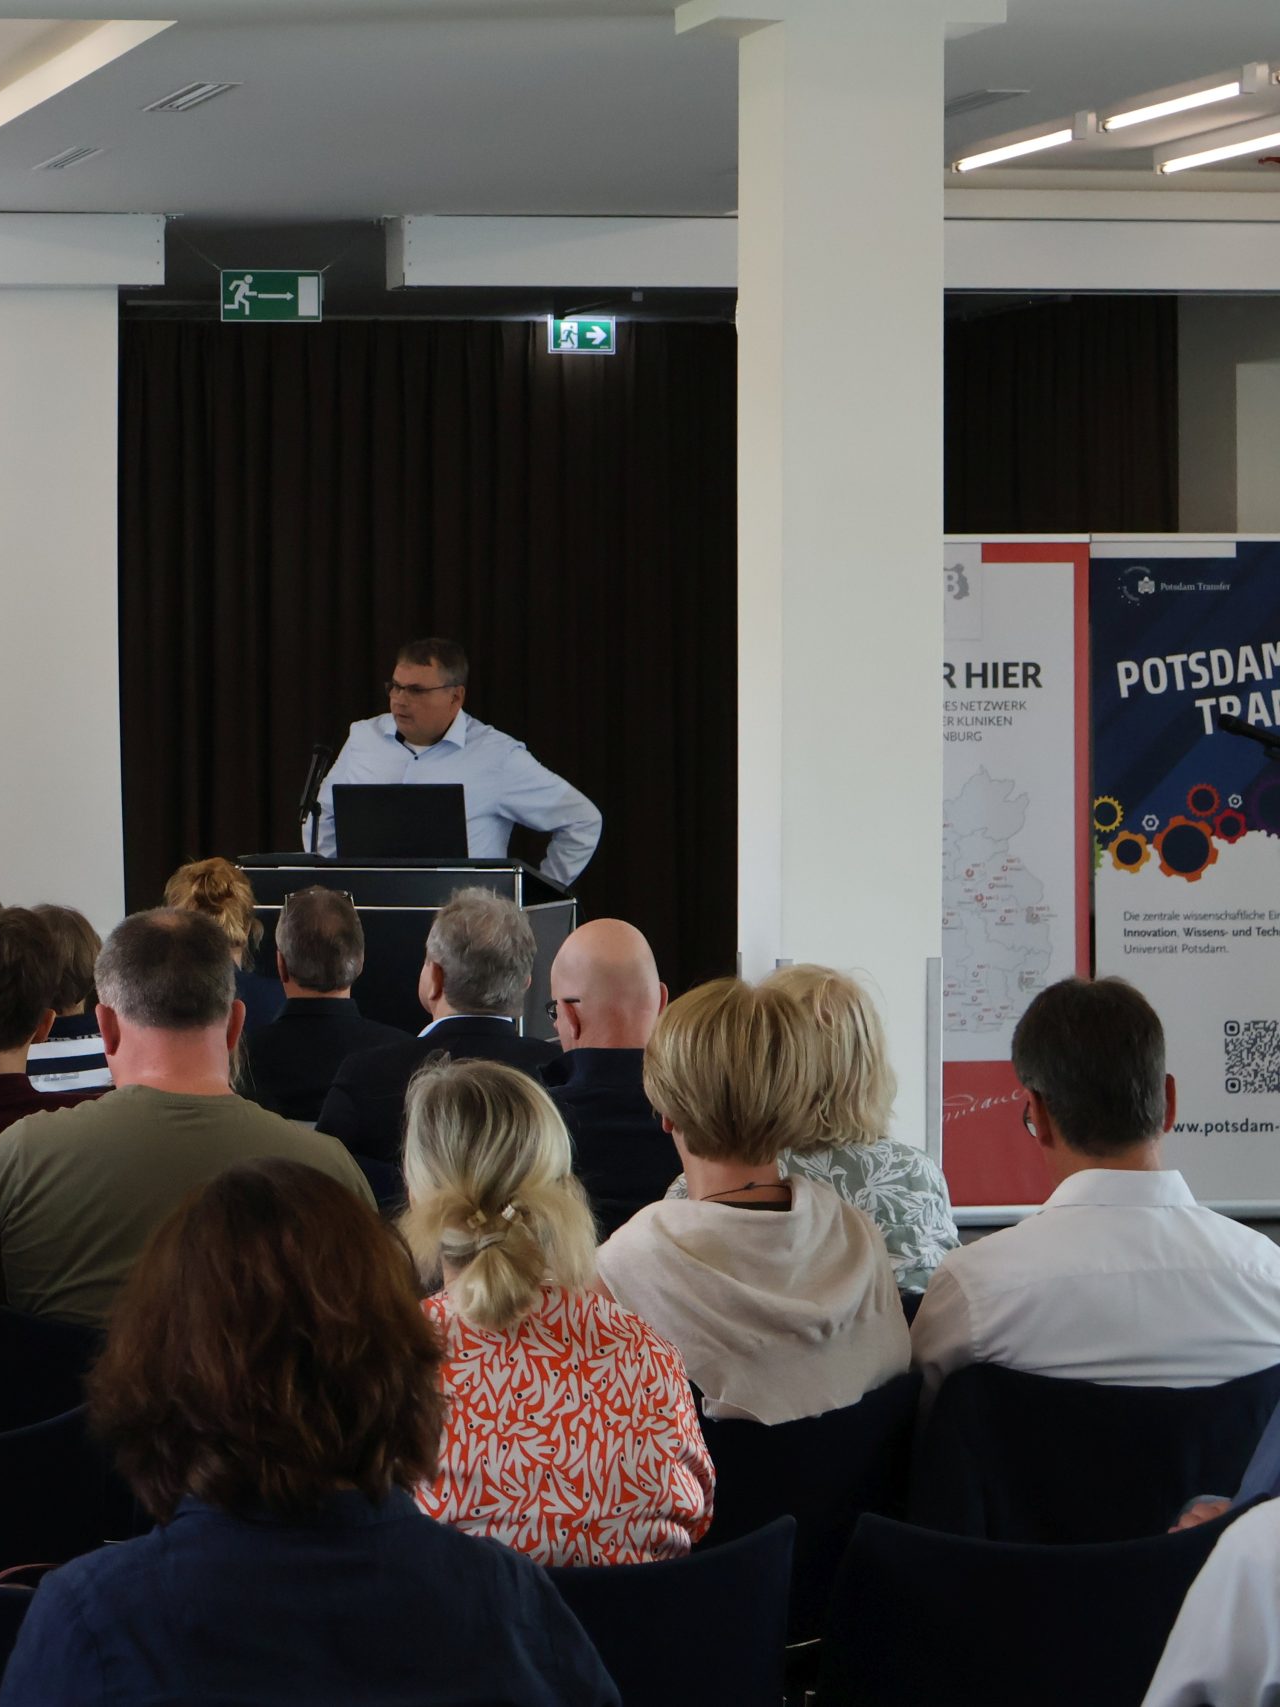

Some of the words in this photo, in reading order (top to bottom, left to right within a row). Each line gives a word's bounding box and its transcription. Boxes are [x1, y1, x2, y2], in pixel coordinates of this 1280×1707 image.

[965, 662, 1042, 688] HIER
[961, 701, 1027, 712] NETZWERK
[957, 716, 1012, 727] KLINIKEN
[943, 731, 983, 742] NBURG
[1123, 911, 1140, 922] Die
[1143, 911, 1180, 921] zentrale
[1183, 909, 1266, 921] wissenschaftliche
[1183, 927, 1228, 937] Wissens-
[1232, 926, 1252, 937] und
[1124, 943, 1178, 955] Universität
